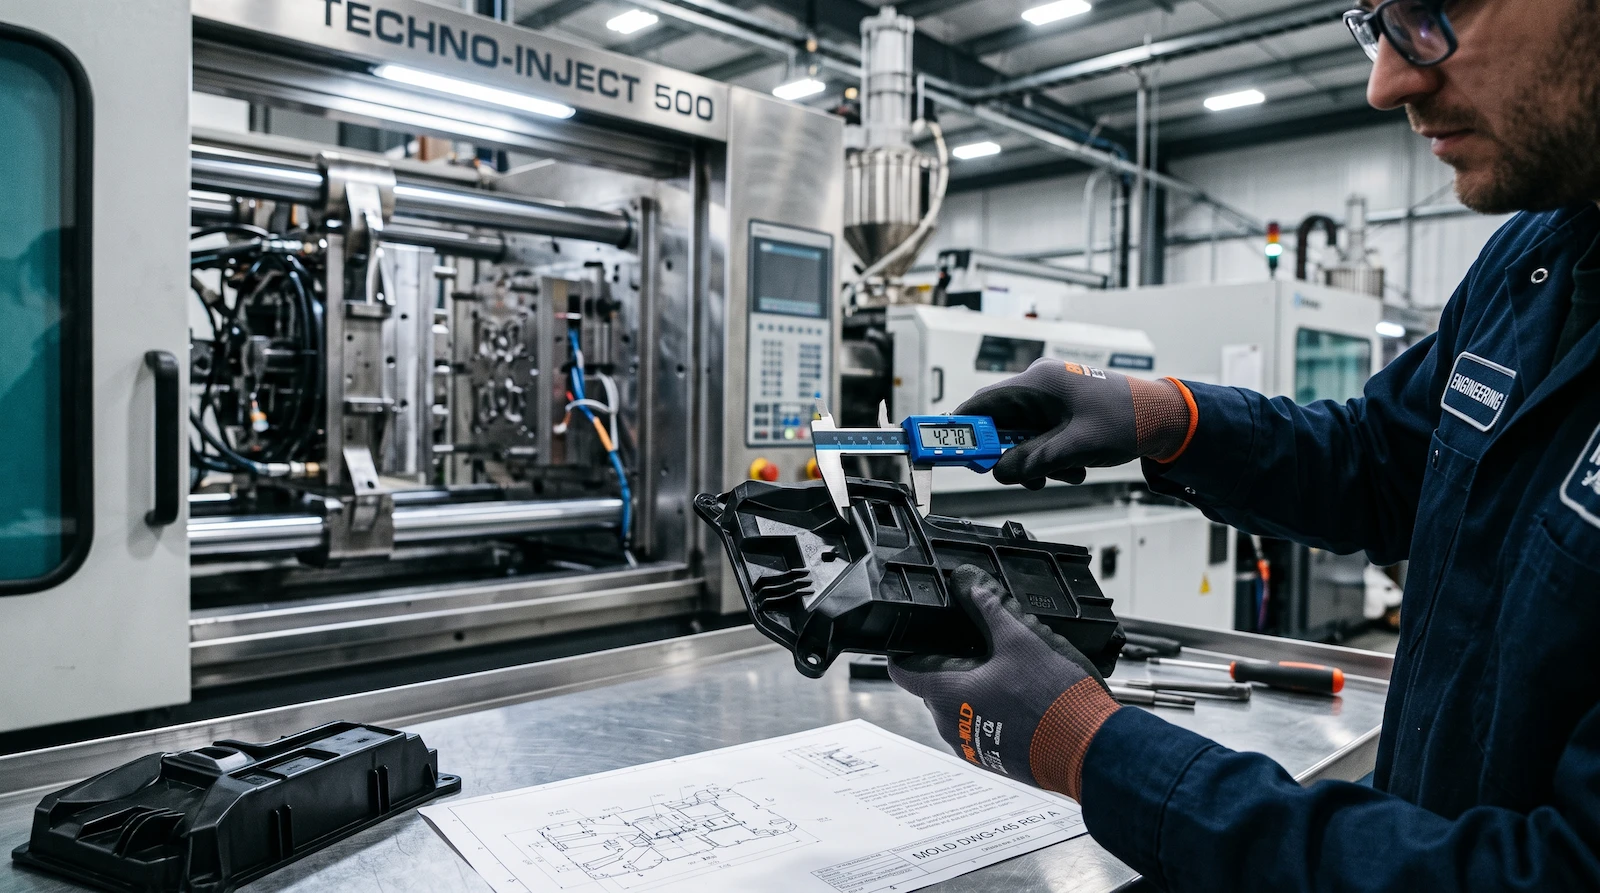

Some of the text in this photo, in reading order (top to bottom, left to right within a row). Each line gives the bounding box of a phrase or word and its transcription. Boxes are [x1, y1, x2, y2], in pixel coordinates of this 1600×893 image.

[323, 0, 713, 121] TECHNO-INJECT 500
[1450, 372, 1504, 411] ENGINEERING
[958, 702, 982, 764] PRO-MOLD
[912, 842, 958, 860] MOLD
[957, 822, 1020, 846] DWG-145
[1018, 813, 1046, 826] REV
[1047, 810, 1061, 818] A
